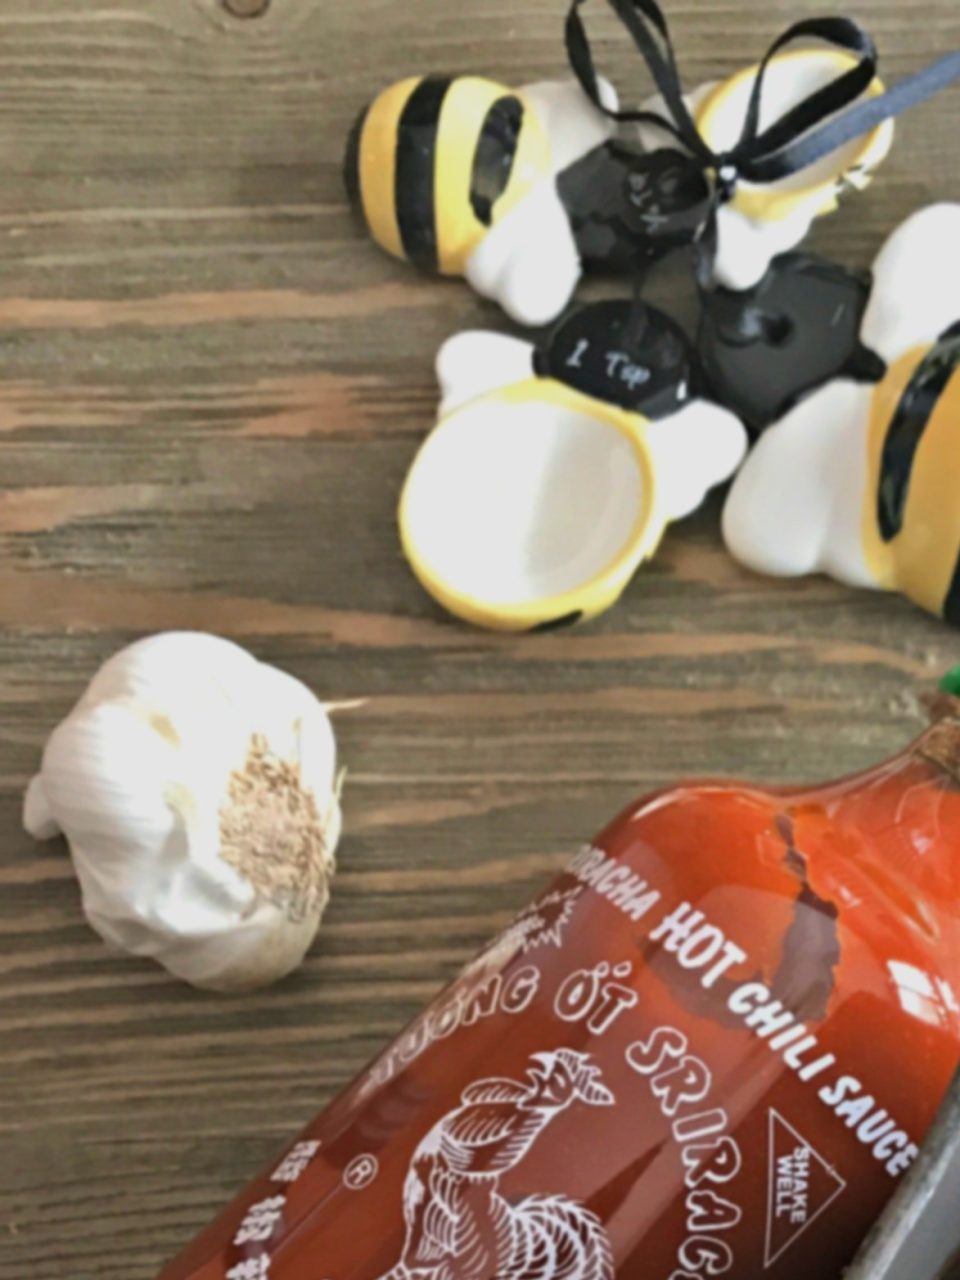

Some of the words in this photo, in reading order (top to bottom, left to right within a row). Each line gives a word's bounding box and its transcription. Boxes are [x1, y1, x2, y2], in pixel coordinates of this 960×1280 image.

[650, 901, 747, 989] HOT
[727, 981, 835, 1084] CHILI
[817, 1075, 919, 1178] SAUCE
[776, 1155, 793, 1218] WELL
[790, 1146, 811, 1224] SHAKE
